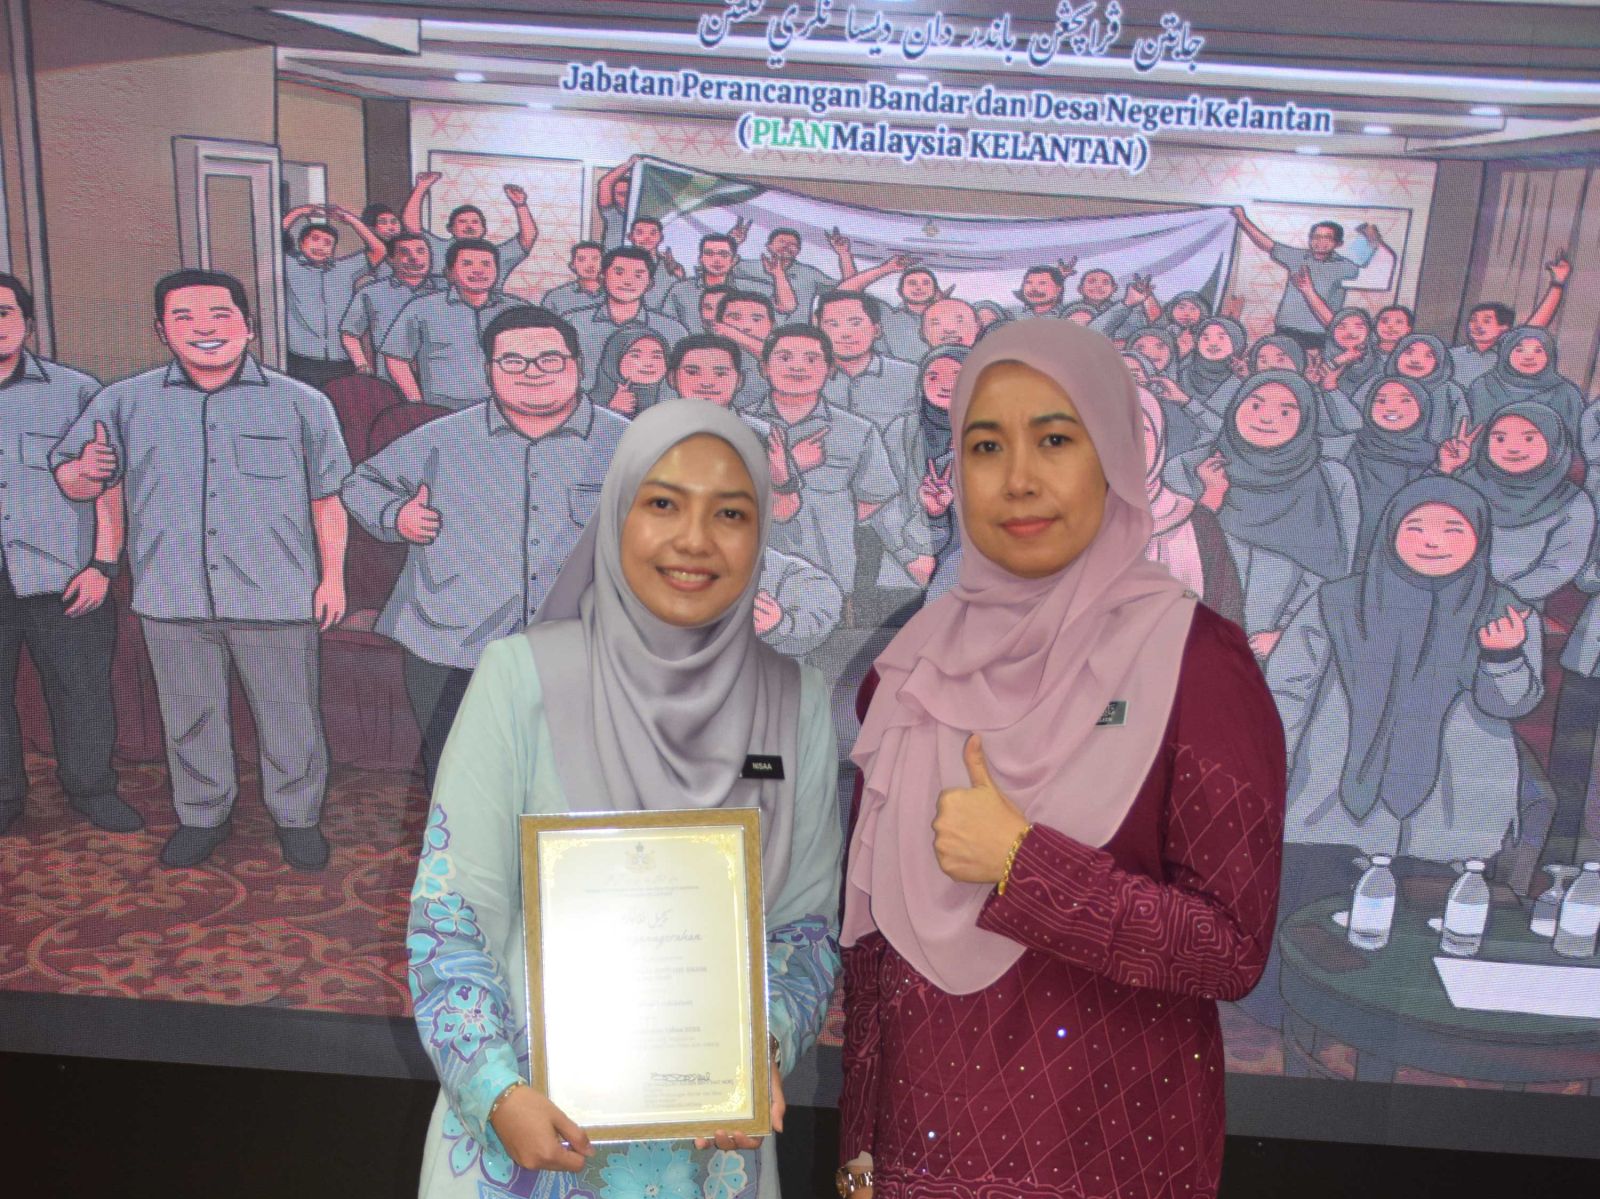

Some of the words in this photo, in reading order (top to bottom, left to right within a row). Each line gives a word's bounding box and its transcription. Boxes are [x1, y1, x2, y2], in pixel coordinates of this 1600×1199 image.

[900, 11, 954, 60] دان
[562, 63, 674, 97] Jabatan
[681, 71, 861, 113] Perancangan
[868, 83, 970, 111] Bandar
[976, 88, 1026, 117] dan
[1034, 93, 1099, 121] Desa
[1105, 96, 1198, 131] Negeri
[1204, 99, 1332, 132] Kelantan
[969, 130, 1148, 171] KELANTAN)
